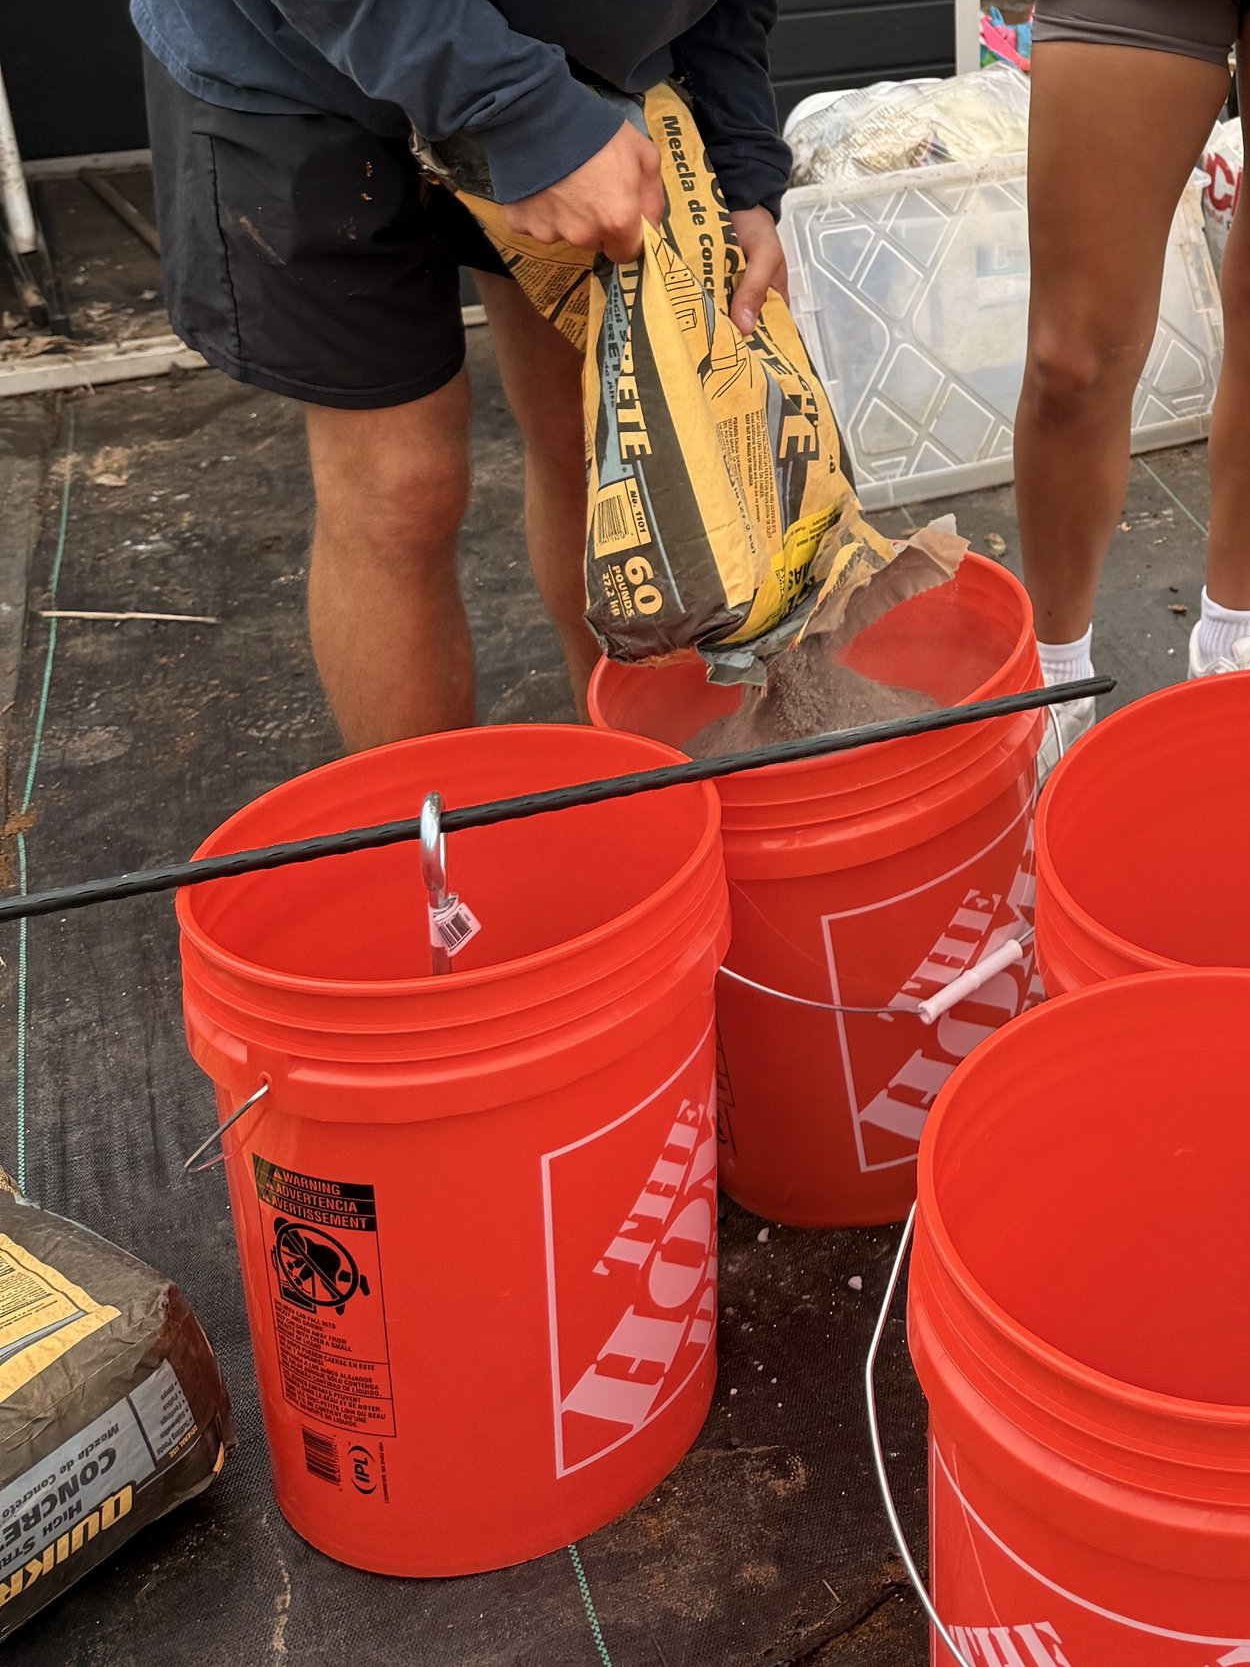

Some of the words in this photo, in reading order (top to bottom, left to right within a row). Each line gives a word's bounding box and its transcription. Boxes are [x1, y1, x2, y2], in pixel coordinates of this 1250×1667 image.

[662, 115, 696, 192] Mezcla
[688, 199, 707, 226] de
[629, 490, 637, 508] No.
[635, 509, 647, 534] 1101
[612, 564, 635, 619] POUNDS
[624, 556, 663, 615] 60
[876, 888, 1003, 1023] THE
[276, 1183, 358, 1213] ADVERTENCIA
[282, 1171, 341, 1196] WARNING
[592, 1098, 706, 1276] THE
[271, 1196, 368, 1229] AVERTISSEMENT
[78, 1422, 120, 1462] Mezcla
[59, 1457, 76, 1475] de
[0, 1447, 117, 1547] CONCRE
[2, 1472, 57, 1520] Concreto
[42, 1499, 83, 1537] HIGH
